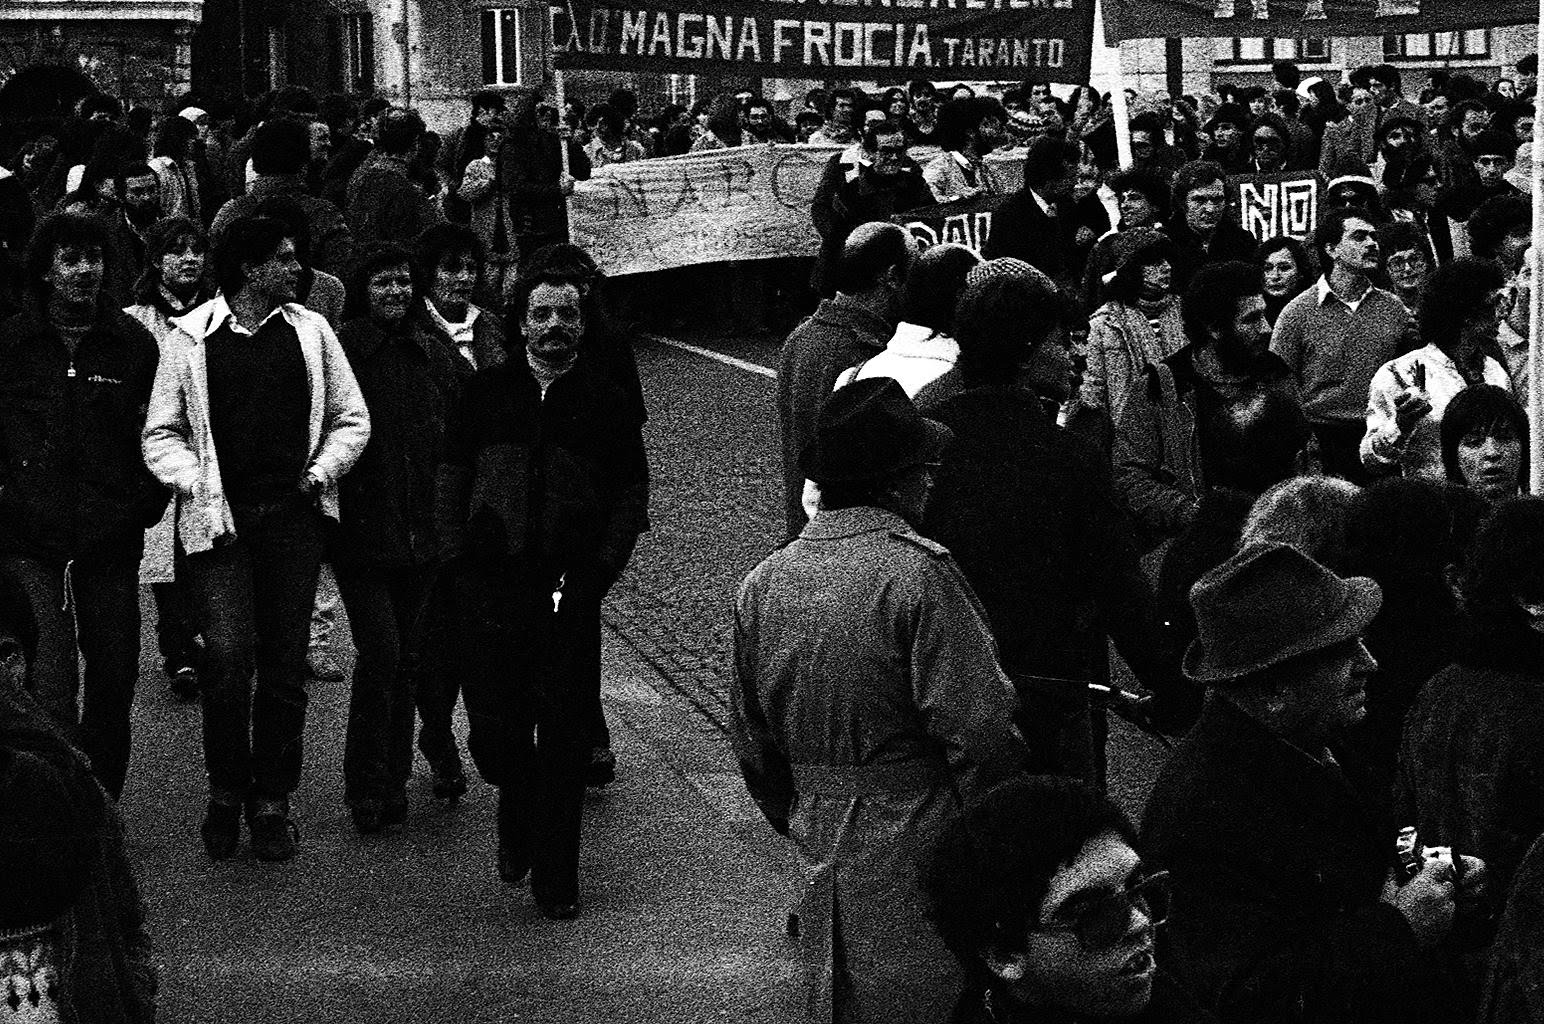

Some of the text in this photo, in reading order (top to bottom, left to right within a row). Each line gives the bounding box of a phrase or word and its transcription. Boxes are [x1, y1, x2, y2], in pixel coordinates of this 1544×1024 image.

[619, 10, 764, 63] MAGNA
[944, 36, 1066, 69] TARANTO
[1239, 178, 1318, 243] NO
